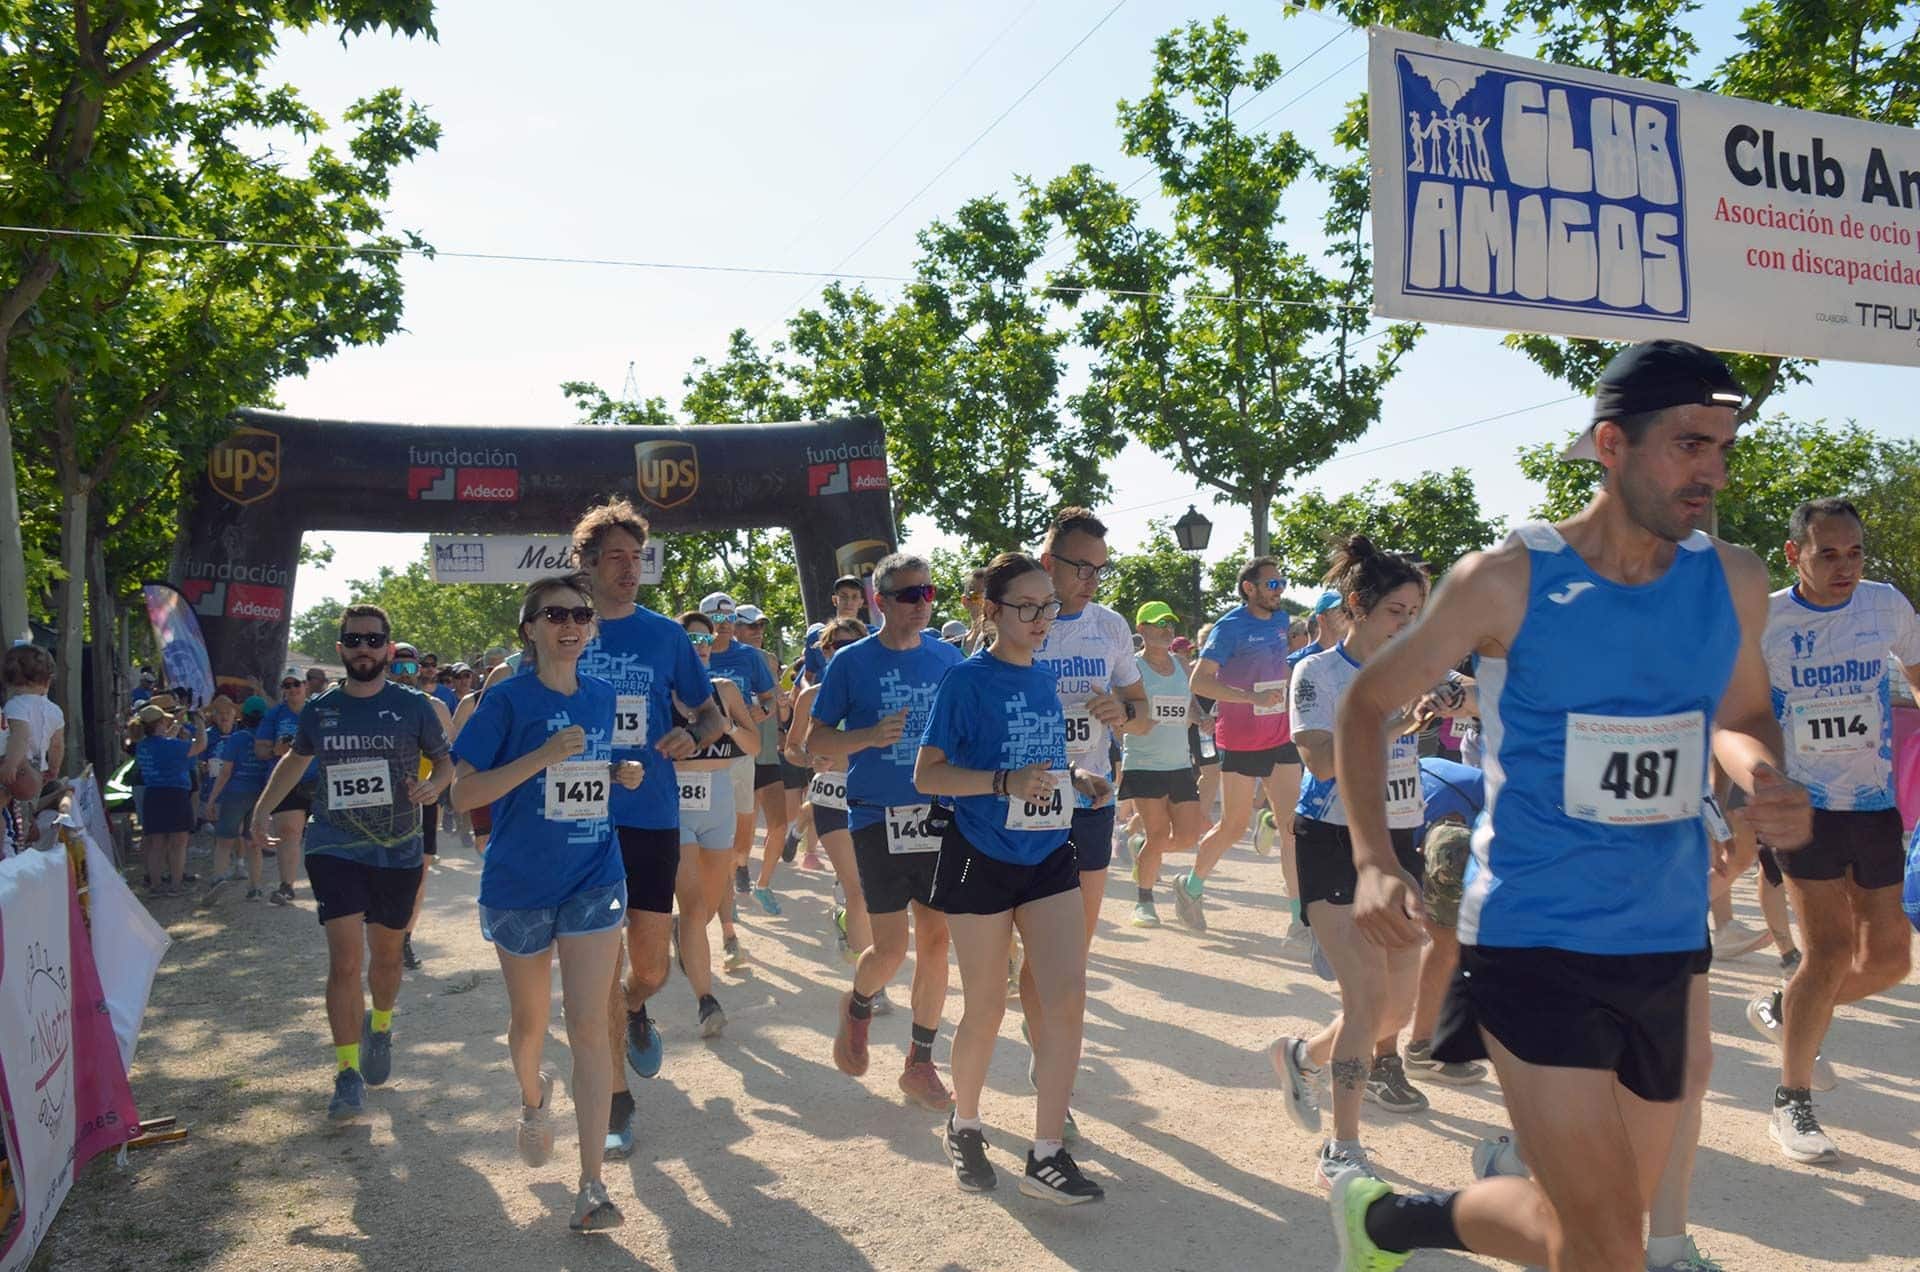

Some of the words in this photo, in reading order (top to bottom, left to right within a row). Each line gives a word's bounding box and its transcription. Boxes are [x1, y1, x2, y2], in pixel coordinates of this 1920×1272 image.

[1501, 80, 1678, 206] CLUB
[1724, 124, 1845, 199] Club
[1714, 196, 1833, 236] Asociación
[1840, 213, 1864, 239] de
[1870, 221, 1911, 246] ocio
[1408, 181, 1684, 314] AMIGOS
[1746, 247, 1786, 270] con
[408, 446, 519, 467] fundación
[213, 447, 276, 493] ups
[639, 457, 695, 499] ups
[463, 484, 515, 499] Adecco
[183, 556, 289, 585] fundación
[231, 601, 281, 618] Adecco
[1041, 655, 1107, 680] gaRun
[1790, 659, 1881, 688] LegaRun
[614, 679, 650, 691] RRERA
[1155, 705, 1186, 718] 1559
[1807, 714, 1868, 740] 1114
[323, 734, 395, 751] runBCN
[1027, 745, 1065, 757] CARRE
[1600, 748, 1679, 800] 487
[333, 776, 385, 797] 1582
[555, 780, 605, 803] 1412
[676, 784, 707, 800] 88
[811, 780, 847, 799] 1600
[889, 818, 931, 841] 140
